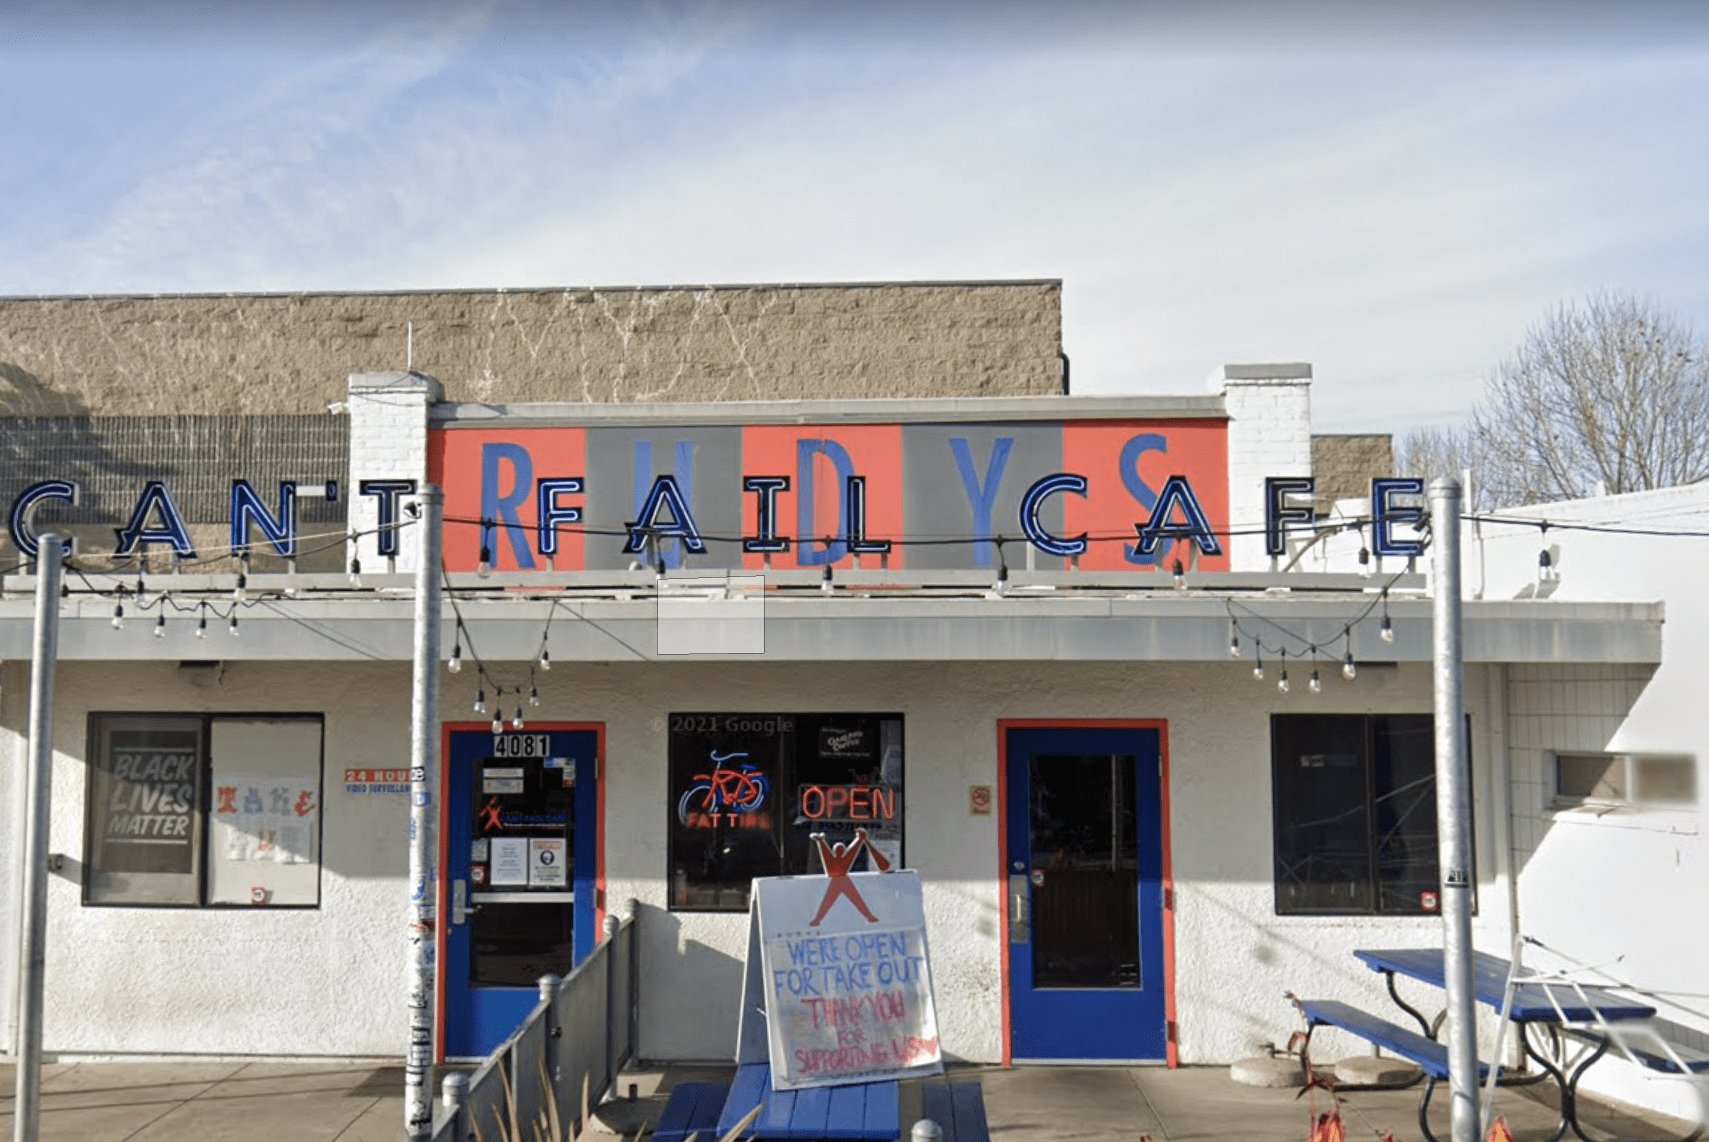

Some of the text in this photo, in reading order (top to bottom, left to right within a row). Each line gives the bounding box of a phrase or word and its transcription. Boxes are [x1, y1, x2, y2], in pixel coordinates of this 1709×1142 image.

[9, 473, 1425, 559] CAN'T FAIL CAFE
[495, 735, 549, 757] 4081
[114, 755, 195, 780] BLACK
[346, 769, 367, 782] 24
[374, 769, 408, 782] HOU
[109, 783, 193, 814] LIVES
[217, 786, 316, 817] TAKE
[803, 785, 895, 820] OPEN
[107, 814, 189, 836] MATTER
[844, 931, 907, 961] OPEN
[773, 955, 926, 998] FOR TAKE OUT
